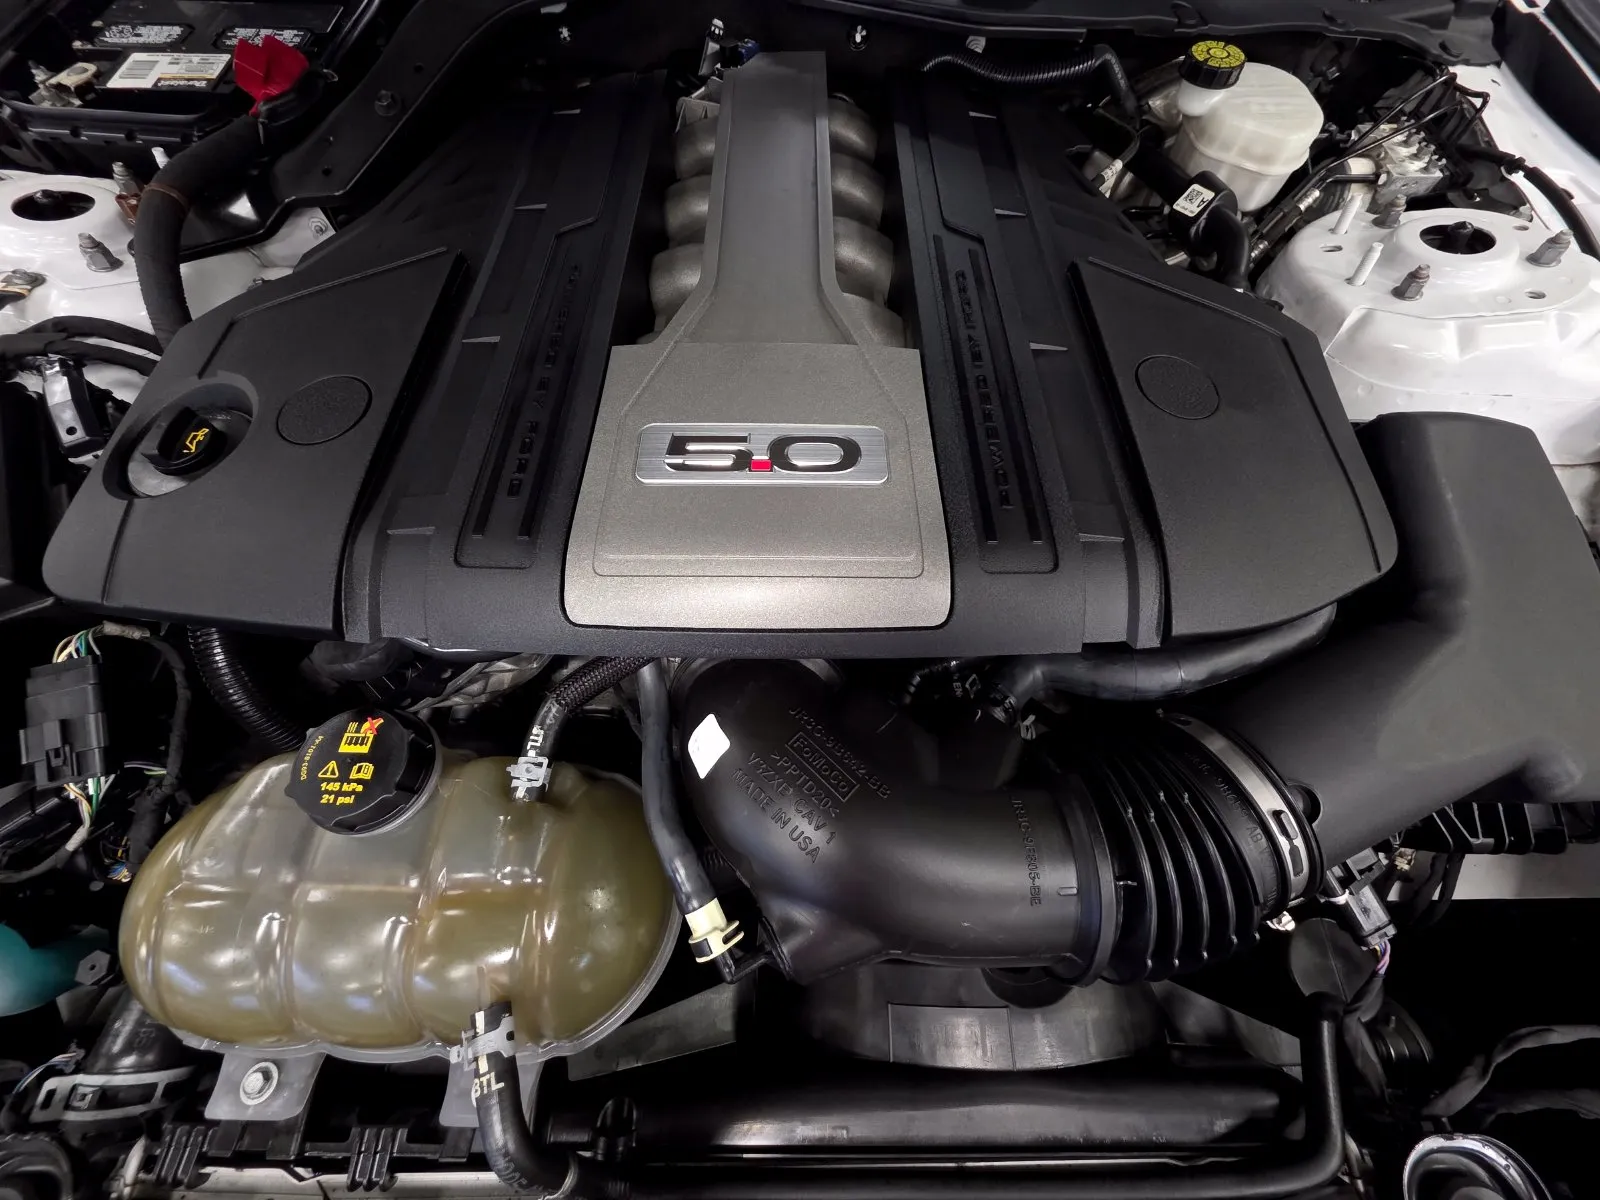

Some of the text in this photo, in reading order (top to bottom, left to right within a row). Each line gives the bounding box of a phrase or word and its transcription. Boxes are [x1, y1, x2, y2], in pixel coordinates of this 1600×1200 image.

[664, 432, 862, 473] 5.0
[792, 738, 850, 792] FoMoCo
[320, 782, 364, 792] 145 kPa
[320, 794, 356, 806] 21 psi
[732, 768, 821, 864] MADE IN USA
[793, 798, 827, 831] CAV
